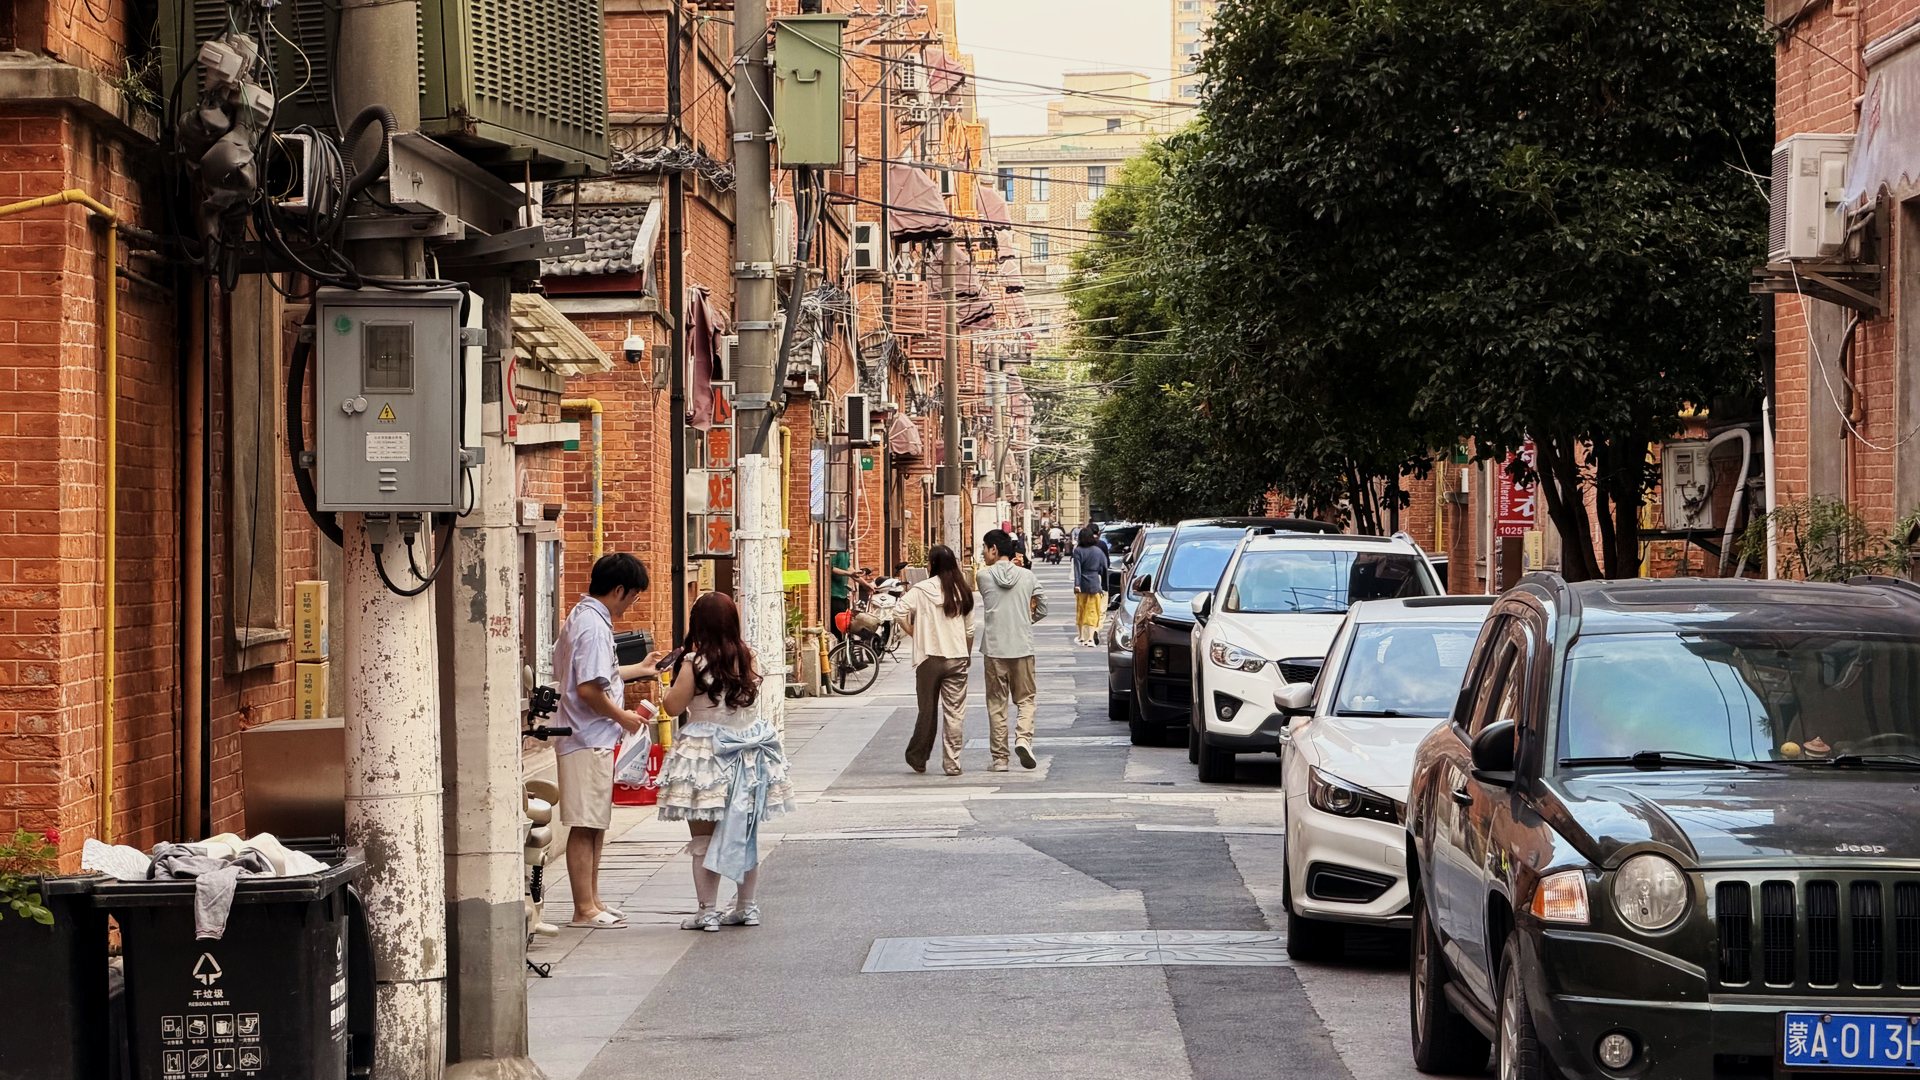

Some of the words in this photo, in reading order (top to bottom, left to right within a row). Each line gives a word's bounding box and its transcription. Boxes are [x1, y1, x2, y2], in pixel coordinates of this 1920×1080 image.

[1500, 480, 1511, 517] Alterations
[1835, 842, 1886, 854] Jeep
[192, 988, 224, 999] 干垃圾
